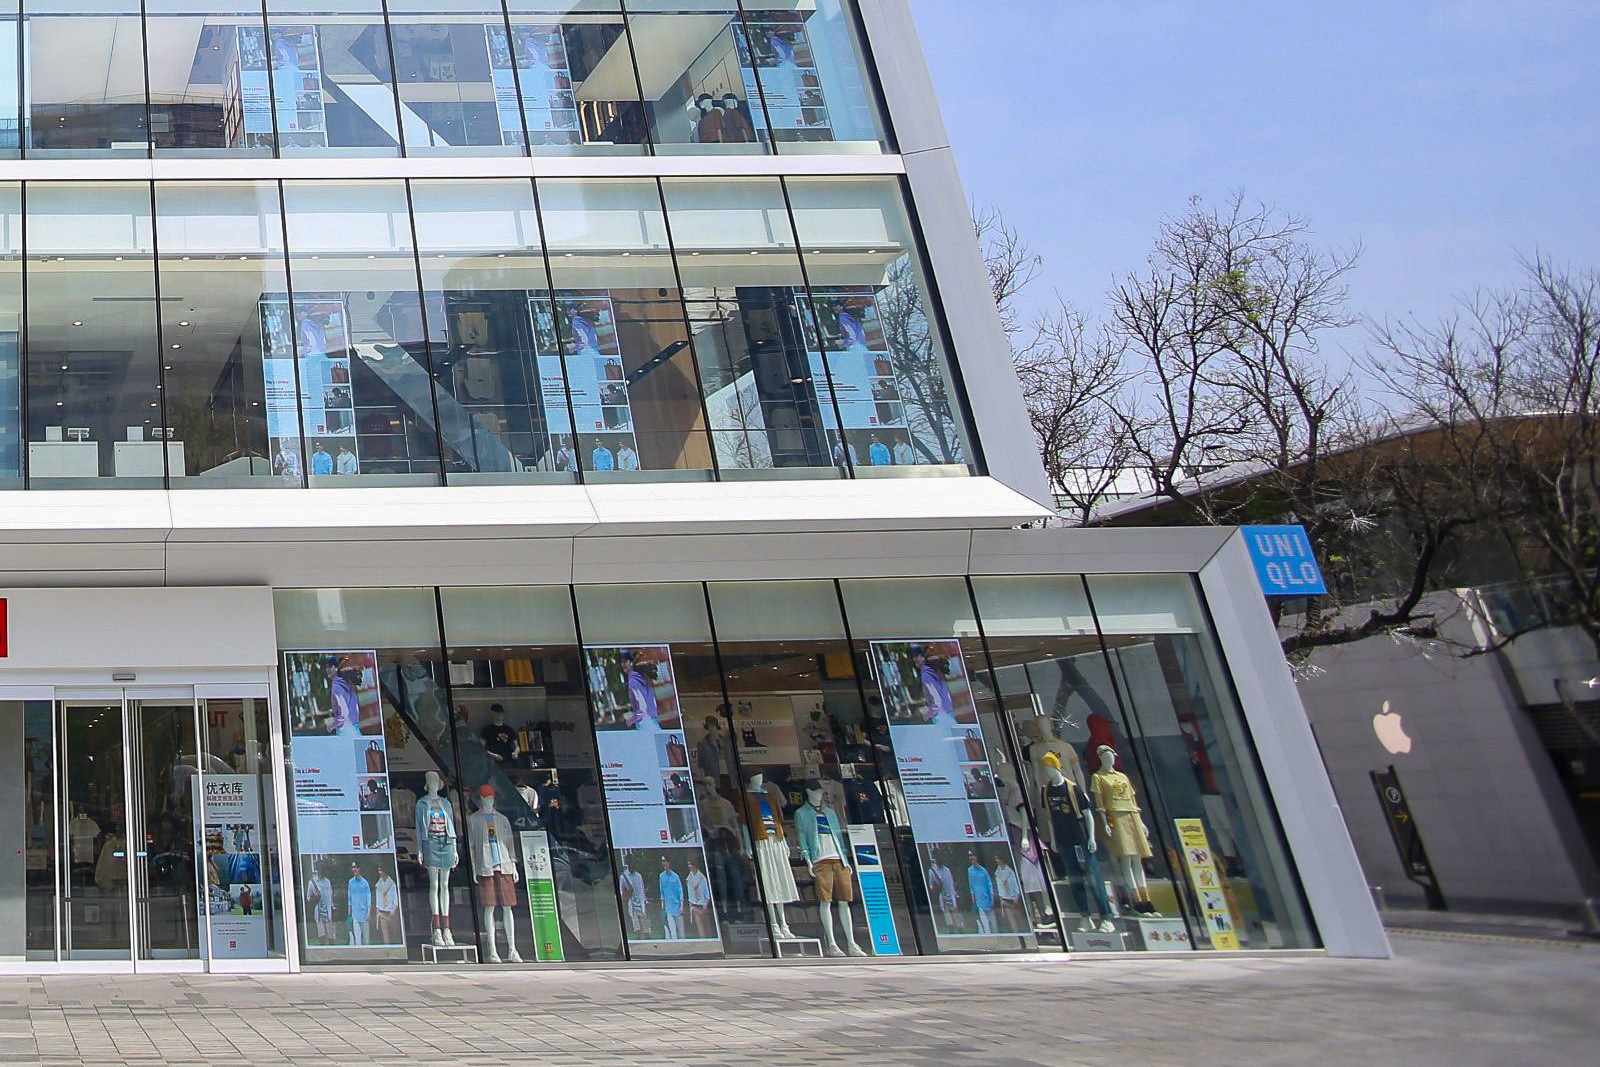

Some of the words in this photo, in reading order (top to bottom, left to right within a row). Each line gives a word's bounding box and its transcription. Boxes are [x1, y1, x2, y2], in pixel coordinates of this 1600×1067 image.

[1254, 534, 1305, 557] UNI
[1266, 561, 1318, 590] QLO
[206, 782, 243, 795] 优衣库
